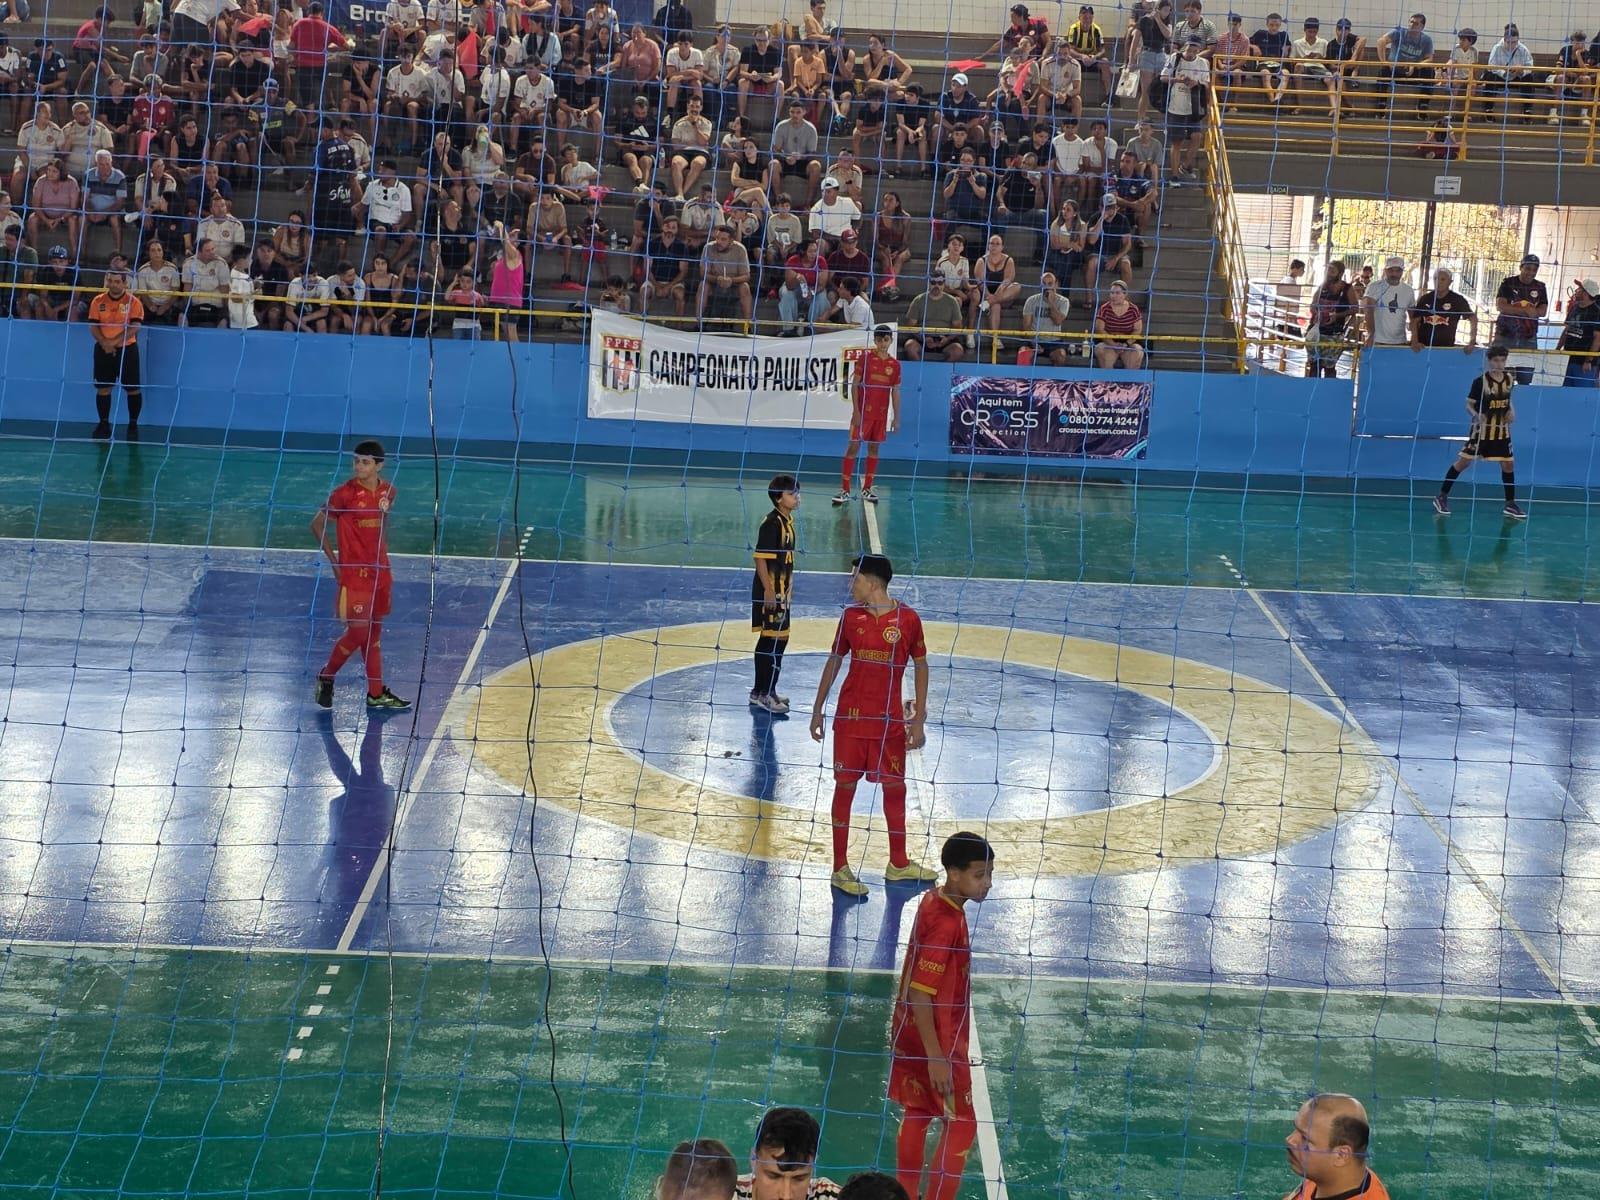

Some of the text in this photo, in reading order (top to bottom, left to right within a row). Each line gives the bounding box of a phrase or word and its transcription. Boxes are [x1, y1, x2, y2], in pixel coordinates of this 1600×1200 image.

[605, 337, 640, 350] FPFS
[650, 350, 838, 393] CAMPEONATO PAULISTA
[978, 397, 1022, 407] Aqui tem
[960, 409, 1039, 428] CROSS
[1069, 415, 1139, 426] 0800 774 4244
